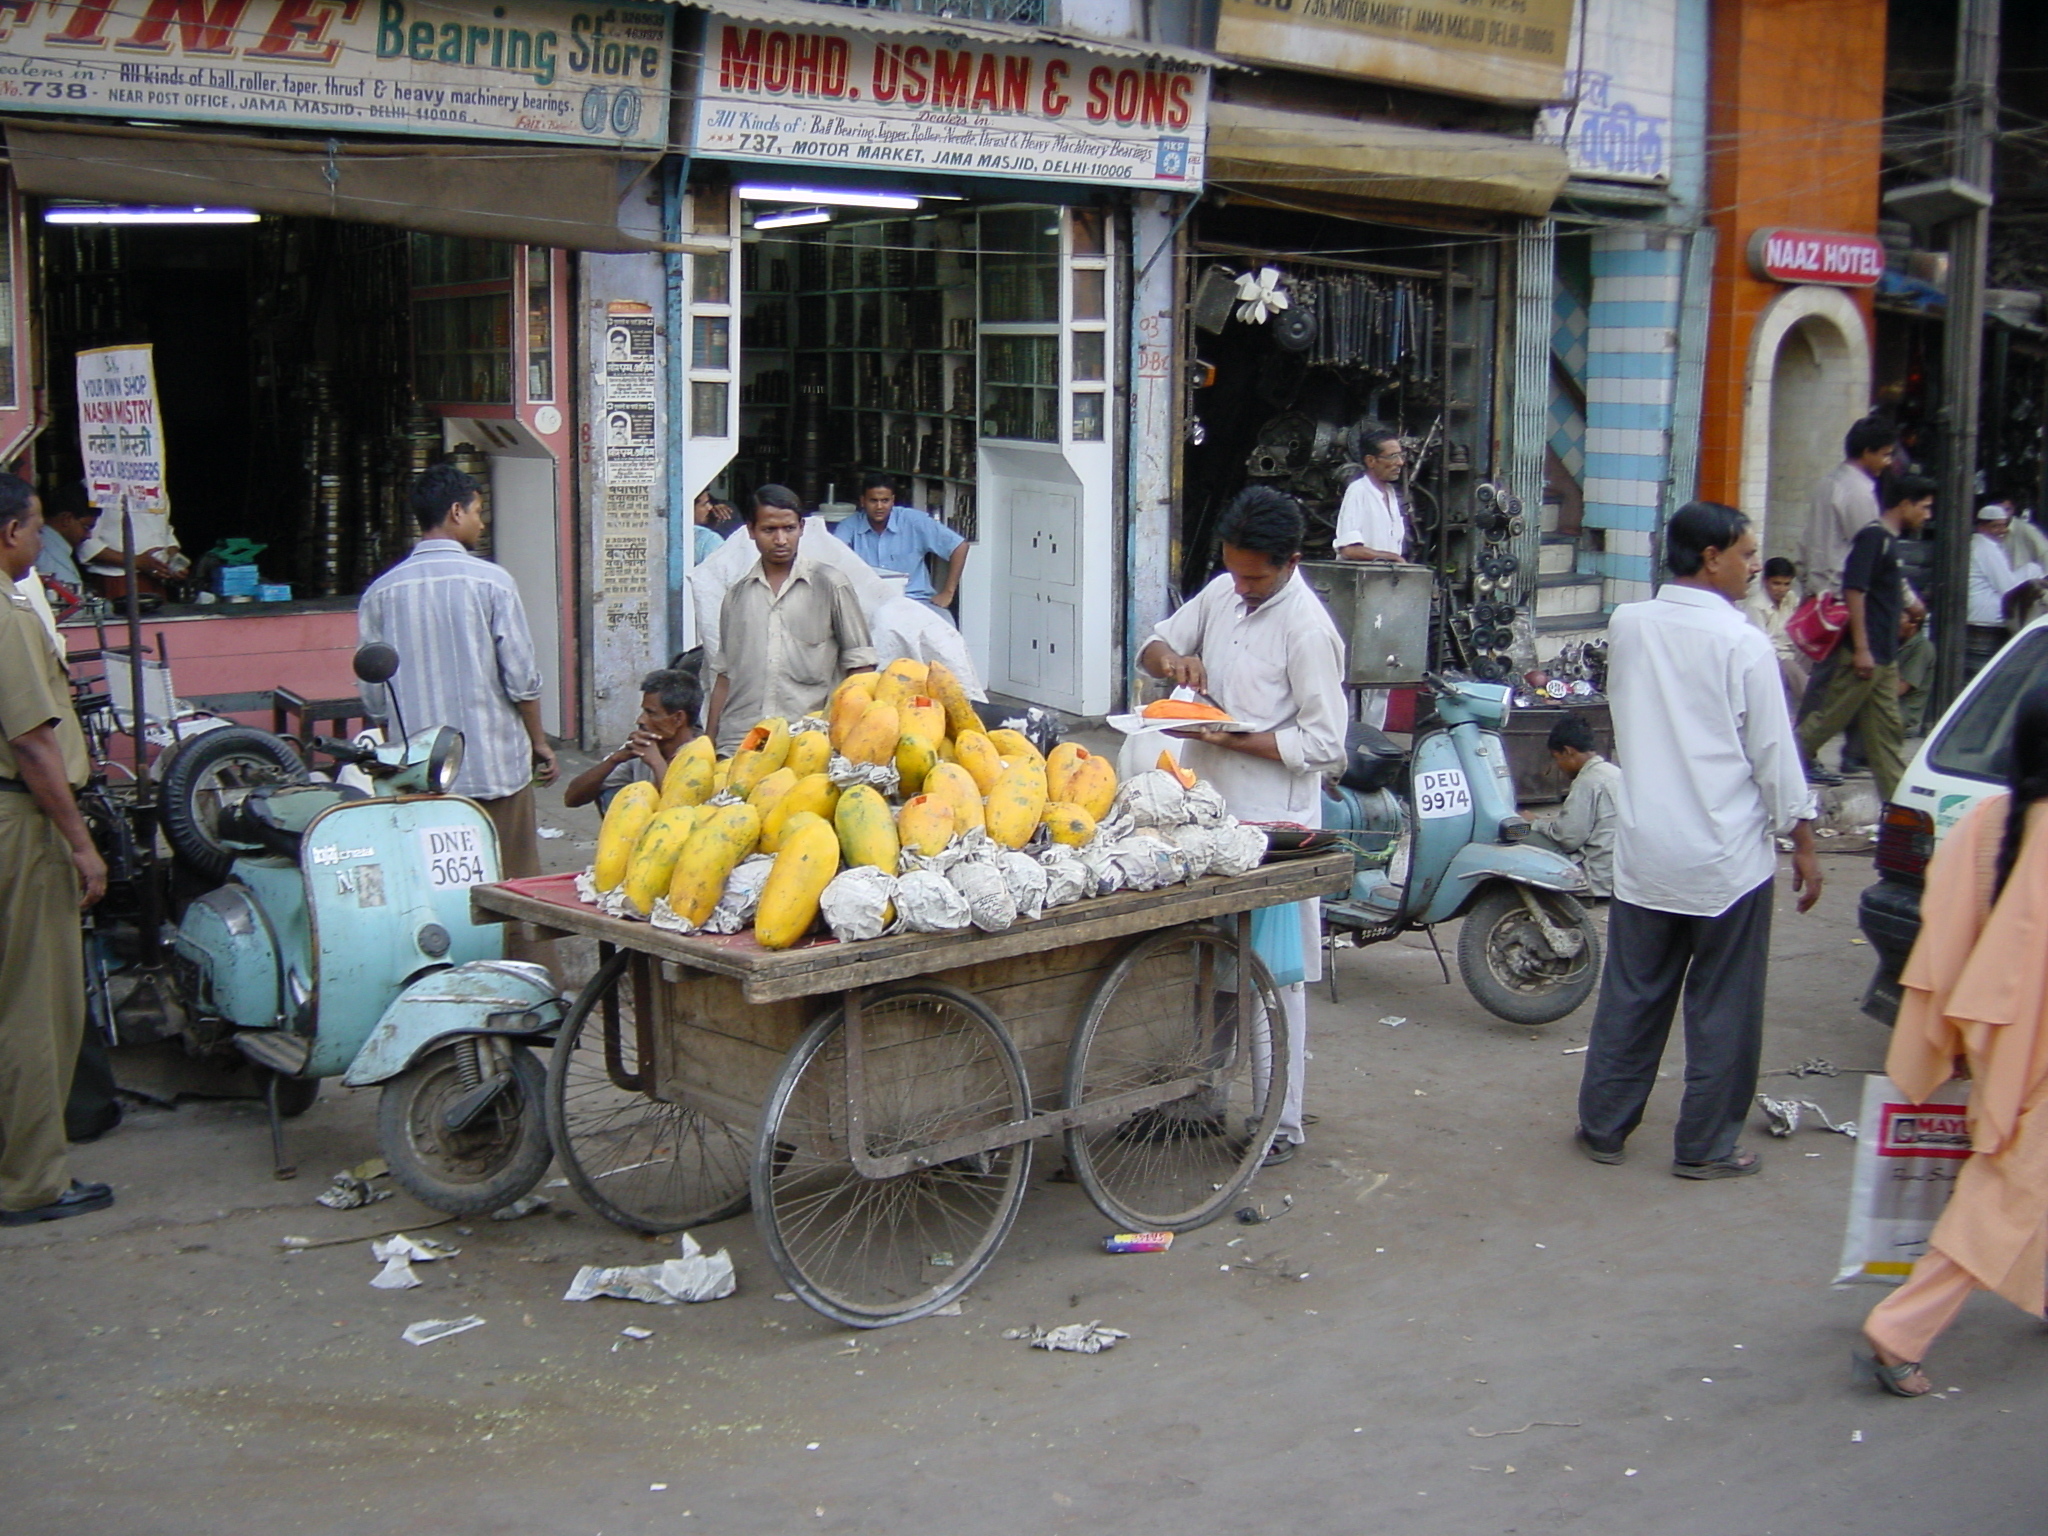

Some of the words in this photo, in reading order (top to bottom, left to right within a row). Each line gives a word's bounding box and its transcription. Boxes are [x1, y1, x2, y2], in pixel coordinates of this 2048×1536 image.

[376, 0, 557, 86] Bearing
[569, 13, 659, 79] Store
[0, 60, 64, 81] ealers
[718, 25, 861, 99] MOHD.
[872, 42, 1029, 114] USMAN
[1041, 59, 1070, 119] &
[1086, 65, 1192, 131] SONS
[108, 88, 144, 104] NEAR
[148, 91, 180, 105] POST
[239, 97, 287, 112] JAMA
[120, 63, 140, 83] All
[143, 64, 185, 86] kinds
[189, 67, 204, 89] of
[325, 76, 364, 98] thrust
[373, 79, 389, 99] &
[394, 81, 444, 109] heavy
[451, 88, 518, 113] machinery
[707, 109, 736, 128] All
[739, 111, 782, 132] Kinds
[1010, 132, 1018, 151] &
[1019, 131, 1049, 156] Heavy
[1052, 135, 1109, 160] Machinery
[791, 141, 849, 158] MOTOR
[930, 150, 973, 168] JAMA
[1767, 238, 1821, 270] NAAZ
[1823, 243, 1882, 276] HOTEL
[84, 378, 104, 397] YOUR
[123, 375, 147, 397] SHOP
[84, 402, 114, 425] NASIM
[114, 399, 153, 425] MISTRY
[90, 460, 116, 479] SHOCK
[1423, 772, 1461, 791] DEU
[1421, 790, 1470, 812] 9974
[430, 831, 474, 855] DNE
[431, 856, 484, 886] 5654
